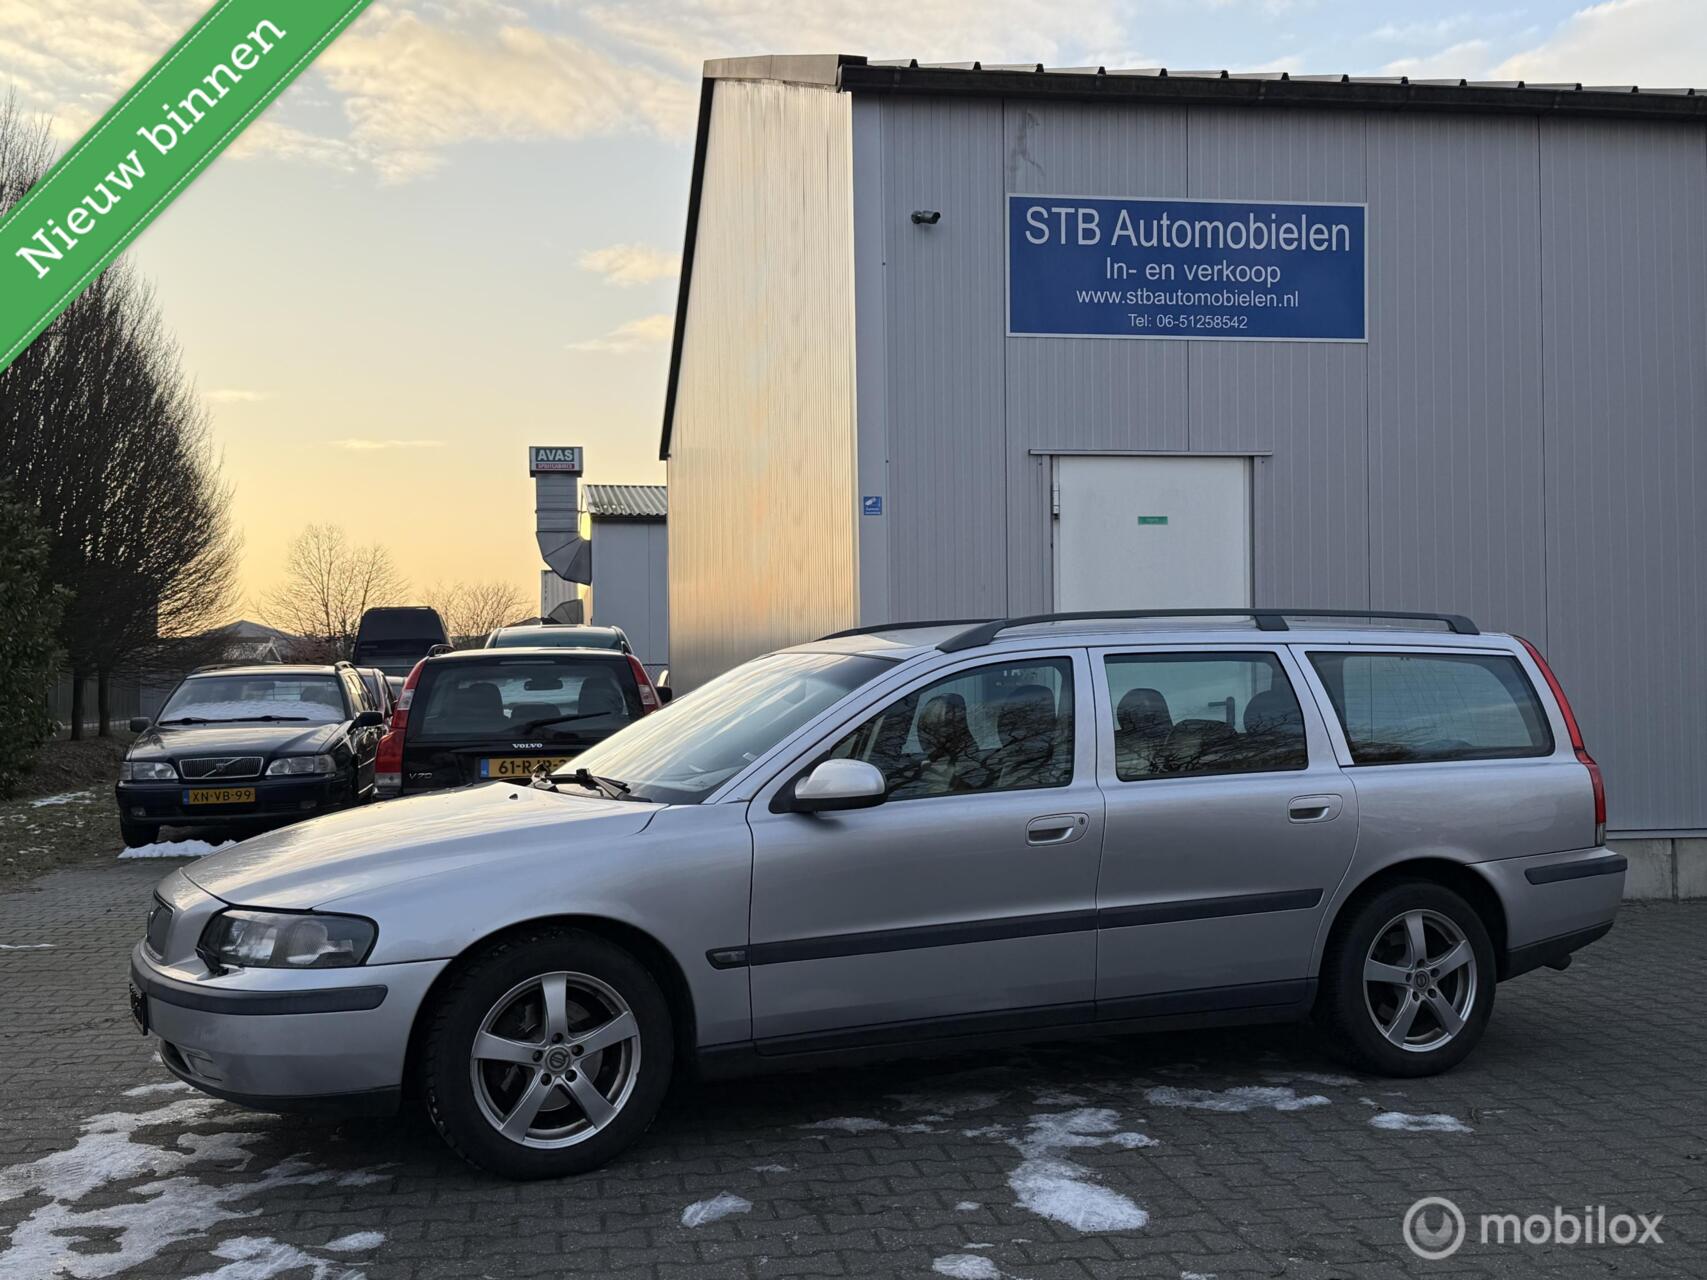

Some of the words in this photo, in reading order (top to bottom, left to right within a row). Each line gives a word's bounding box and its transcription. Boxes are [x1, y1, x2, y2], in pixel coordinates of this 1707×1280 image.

[1025, 206, 1101, 246] STB
[1111, 209, 1350, 251] Automobielen
[1106, 257, 1137, 280] In-
[1145, 263, 1175, 281] en
[1184, 260, 1281, 287] verkoop
[1076, 288, 1299, 308] www.stbautomobielen.nl
[1128, 313, 1152, 328] Tel:
[1156, 314, 1248, 329] 06-51258542
[537, 449, 573, 461] AVAS
[192, 789, 252, 802] XN-VB-99
